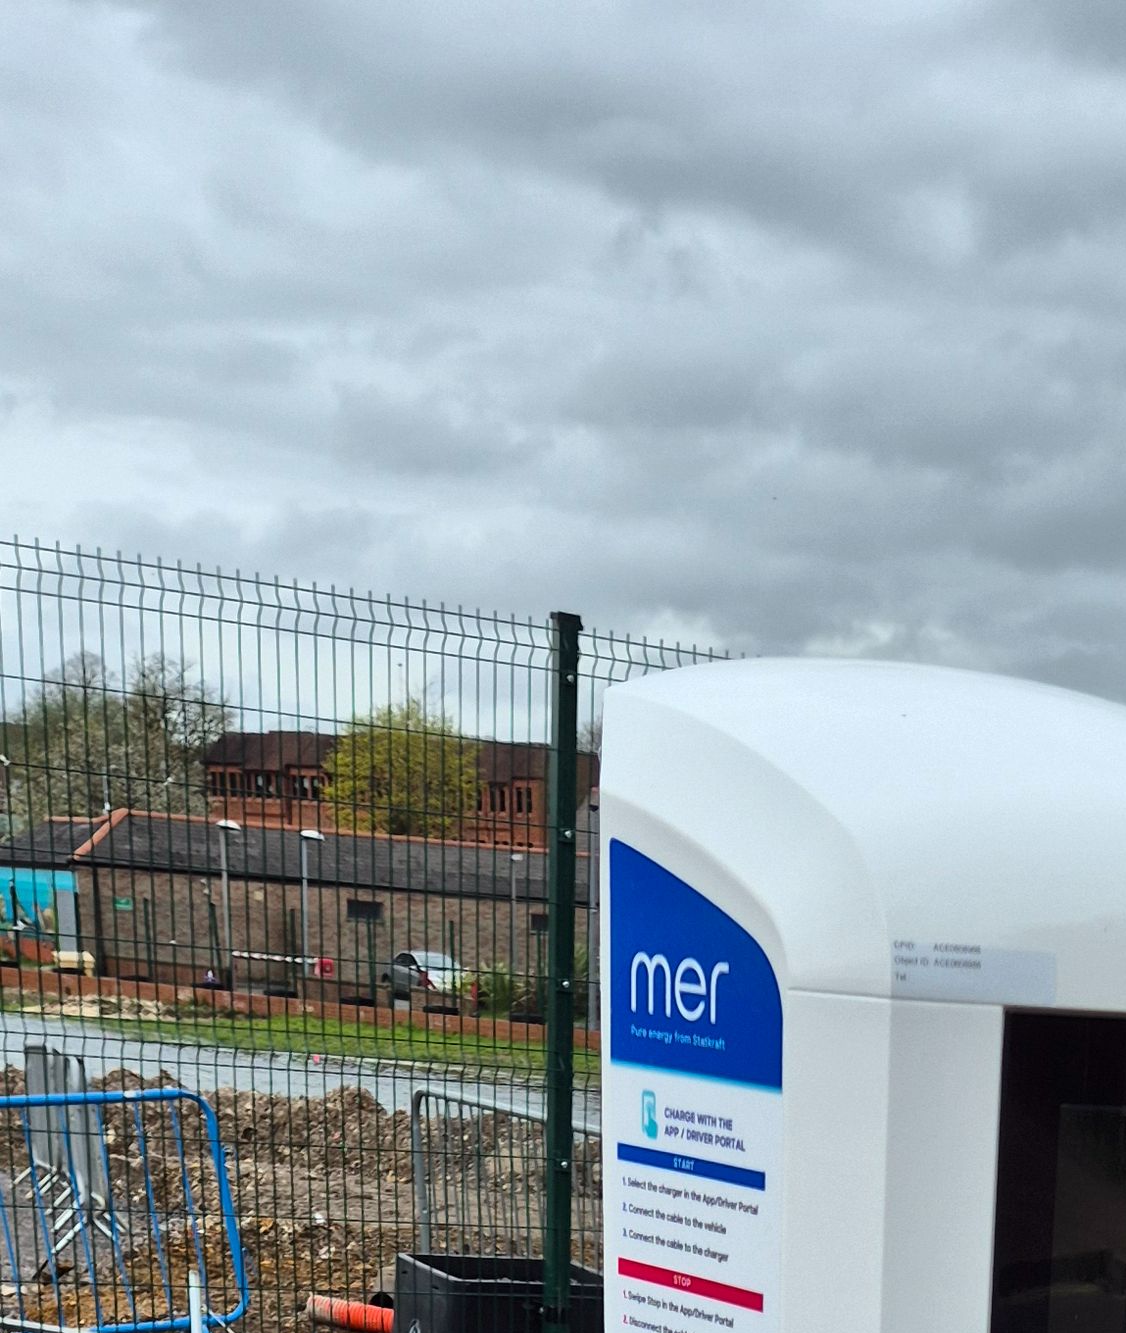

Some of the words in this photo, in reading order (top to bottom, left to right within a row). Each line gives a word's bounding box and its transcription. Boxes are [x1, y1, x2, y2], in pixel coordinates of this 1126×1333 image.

[630, 951, 730, 1025] mer
[649, 1028, 672, 1045] energy
[674, 1031, 691, 1045] from
[664, 1107, 696, 1124] CHARGE
[697, 1114, 717, 1127] WITH
[719, 1117, 733, 1131] THE
[665, 1125, 679, 1137] APP
[686, 1129, 713, 1145] DRIVER
[715, 1135, 745, 1152] PORTAL
[673, 1157, 694, 1170] START
[628, 1204, 654, 1218] Connect
[655, 1210, 666, 1220] the
[666, 1214, 684, 1224] cable
[692, 1218, 703, 1229] the
[704, 1222, 727, 1234] vehicle
[673, 1275, 691, 1287] STOP
